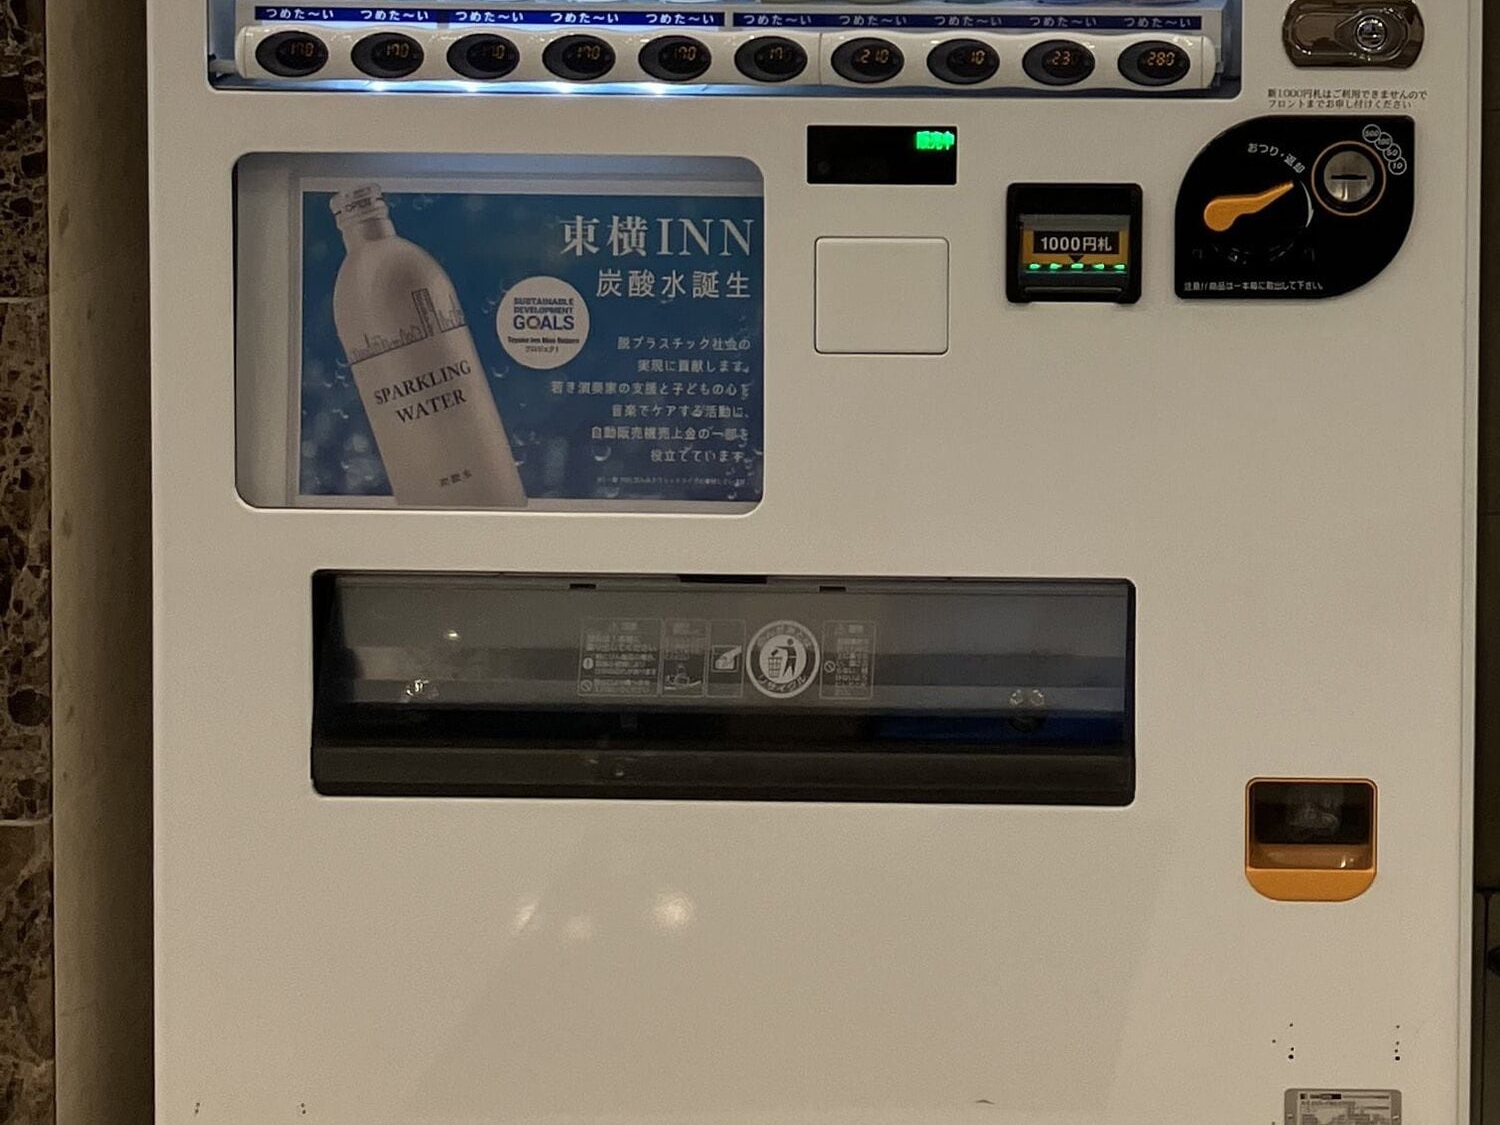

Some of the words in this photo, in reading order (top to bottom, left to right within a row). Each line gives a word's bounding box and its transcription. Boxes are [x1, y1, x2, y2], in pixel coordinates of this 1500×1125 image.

[1147, 51, 1175, 66] 280
[560, 214, 755, 257] 東横INN
[1040, 236, 1113, 254] 1000円札
[596, 269, 752, 300] 炭酸水誕生
[513, 315, 574, 330] GOALS
[375, 359, 472, 406] SPARKLING
[396, 388, 468, 425] WATER
